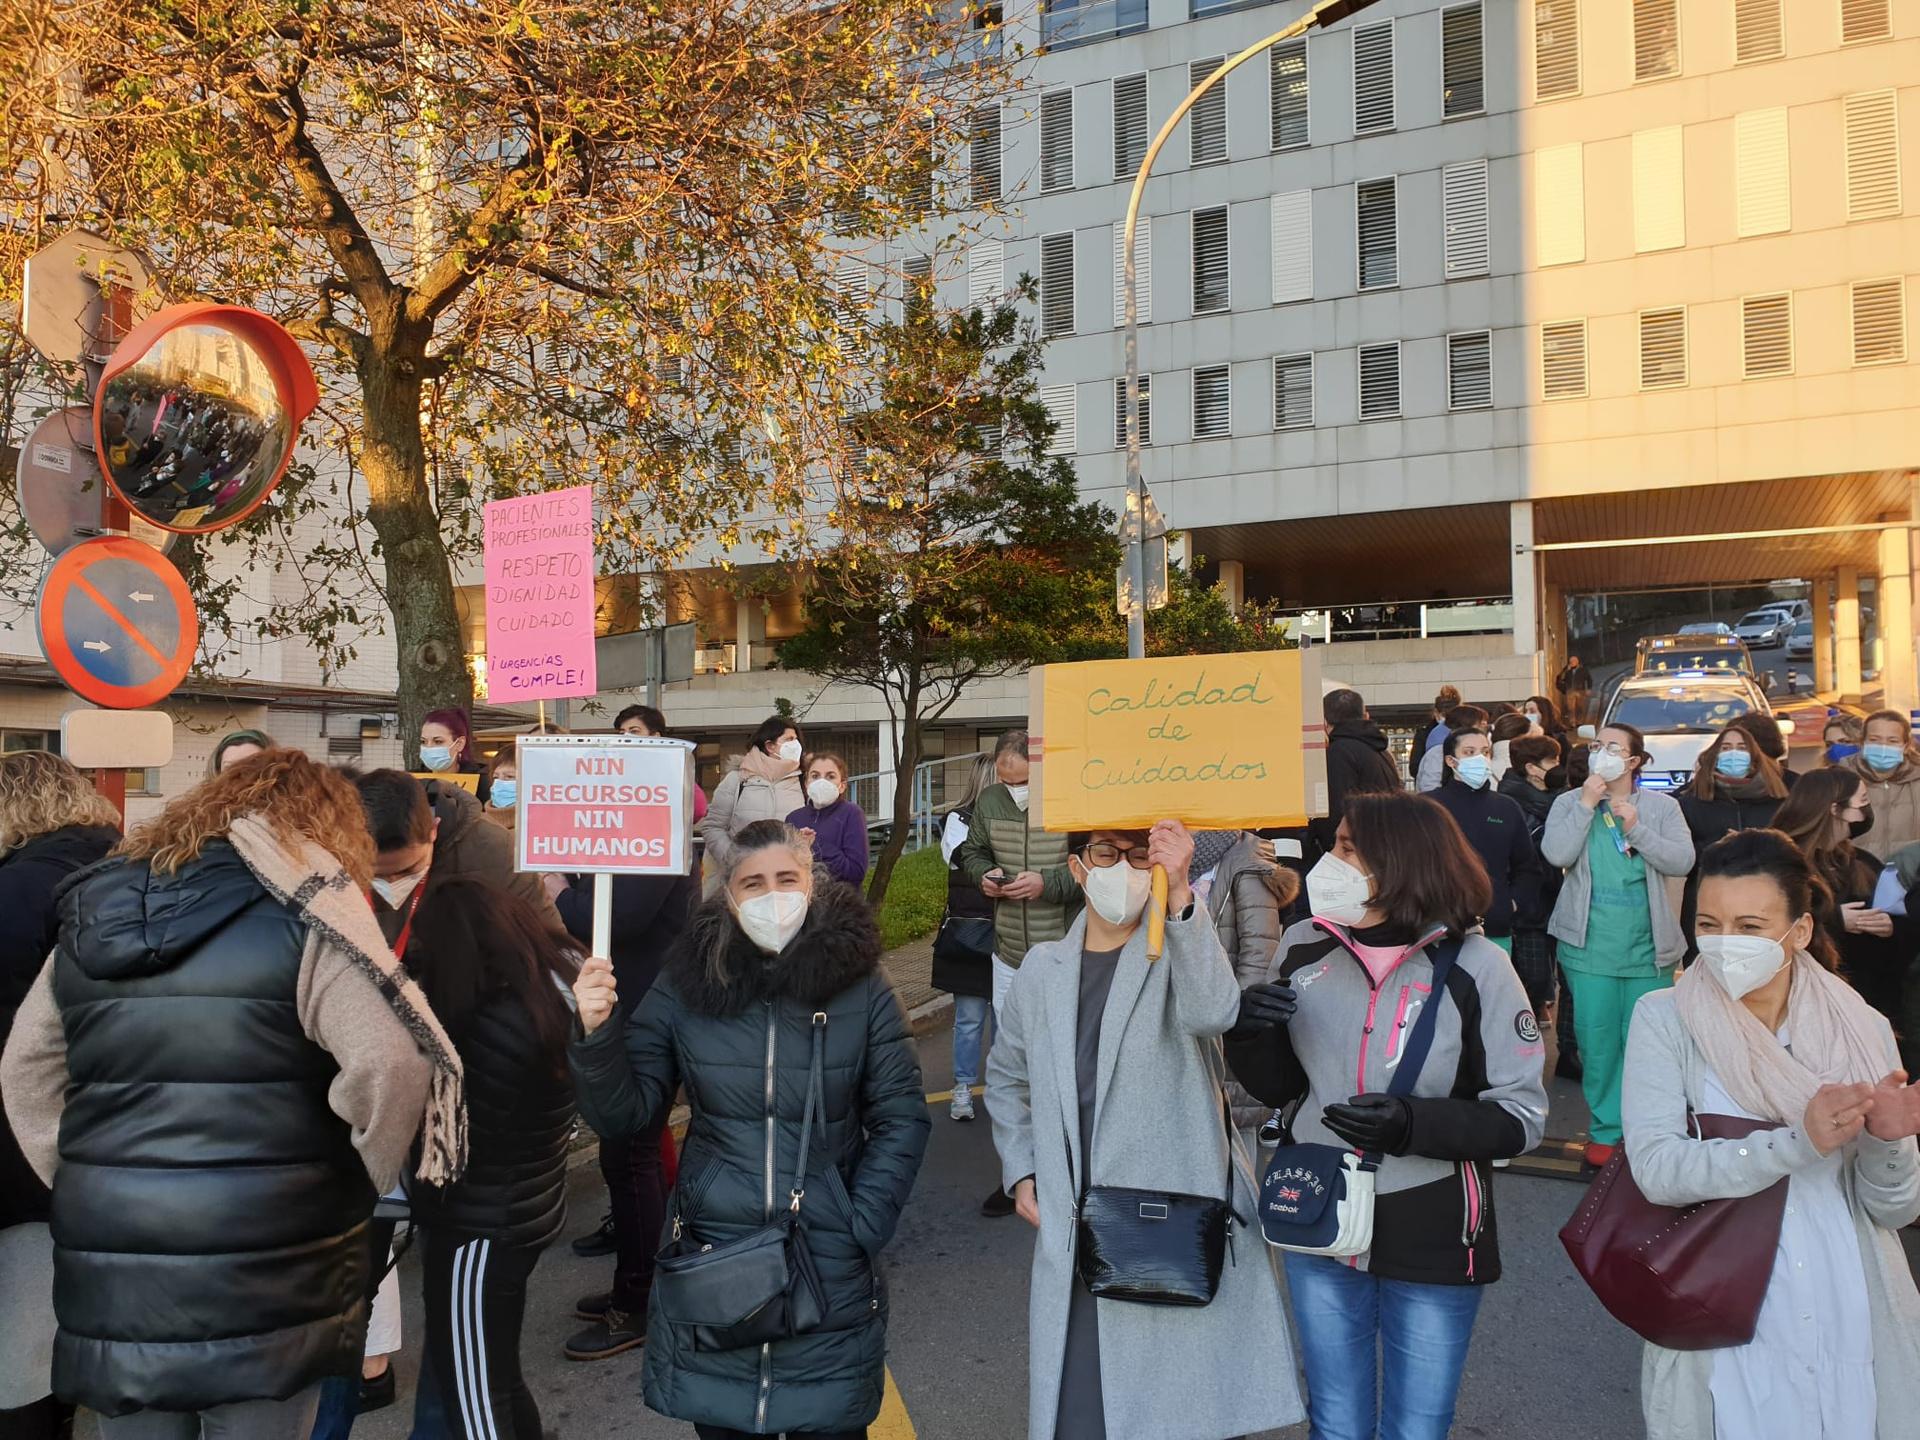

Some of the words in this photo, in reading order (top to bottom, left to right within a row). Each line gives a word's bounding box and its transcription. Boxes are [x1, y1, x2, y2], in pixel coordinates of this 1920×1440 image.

[491, 497, 580, 527] PACIENTES
[491, 522, 590, 548] PROFESIONALES
[501, 552, 582, 578] RESPETO
[492, 582, 580, 604] DIGNIDAD
[497, 611, 574, 632] CUIDADO
[1088, 672, 1274, 715] Calidad
[1148, 714, 1192, 741] de
[576, 758, 624, 775] NIN
[1081, 752, 1267, 790] Cuidados
[531, 784, 668, 803] RECURSOS
[574, 810, 623, 828] NIN
[533, 837, 665, 857] HUMANOS
